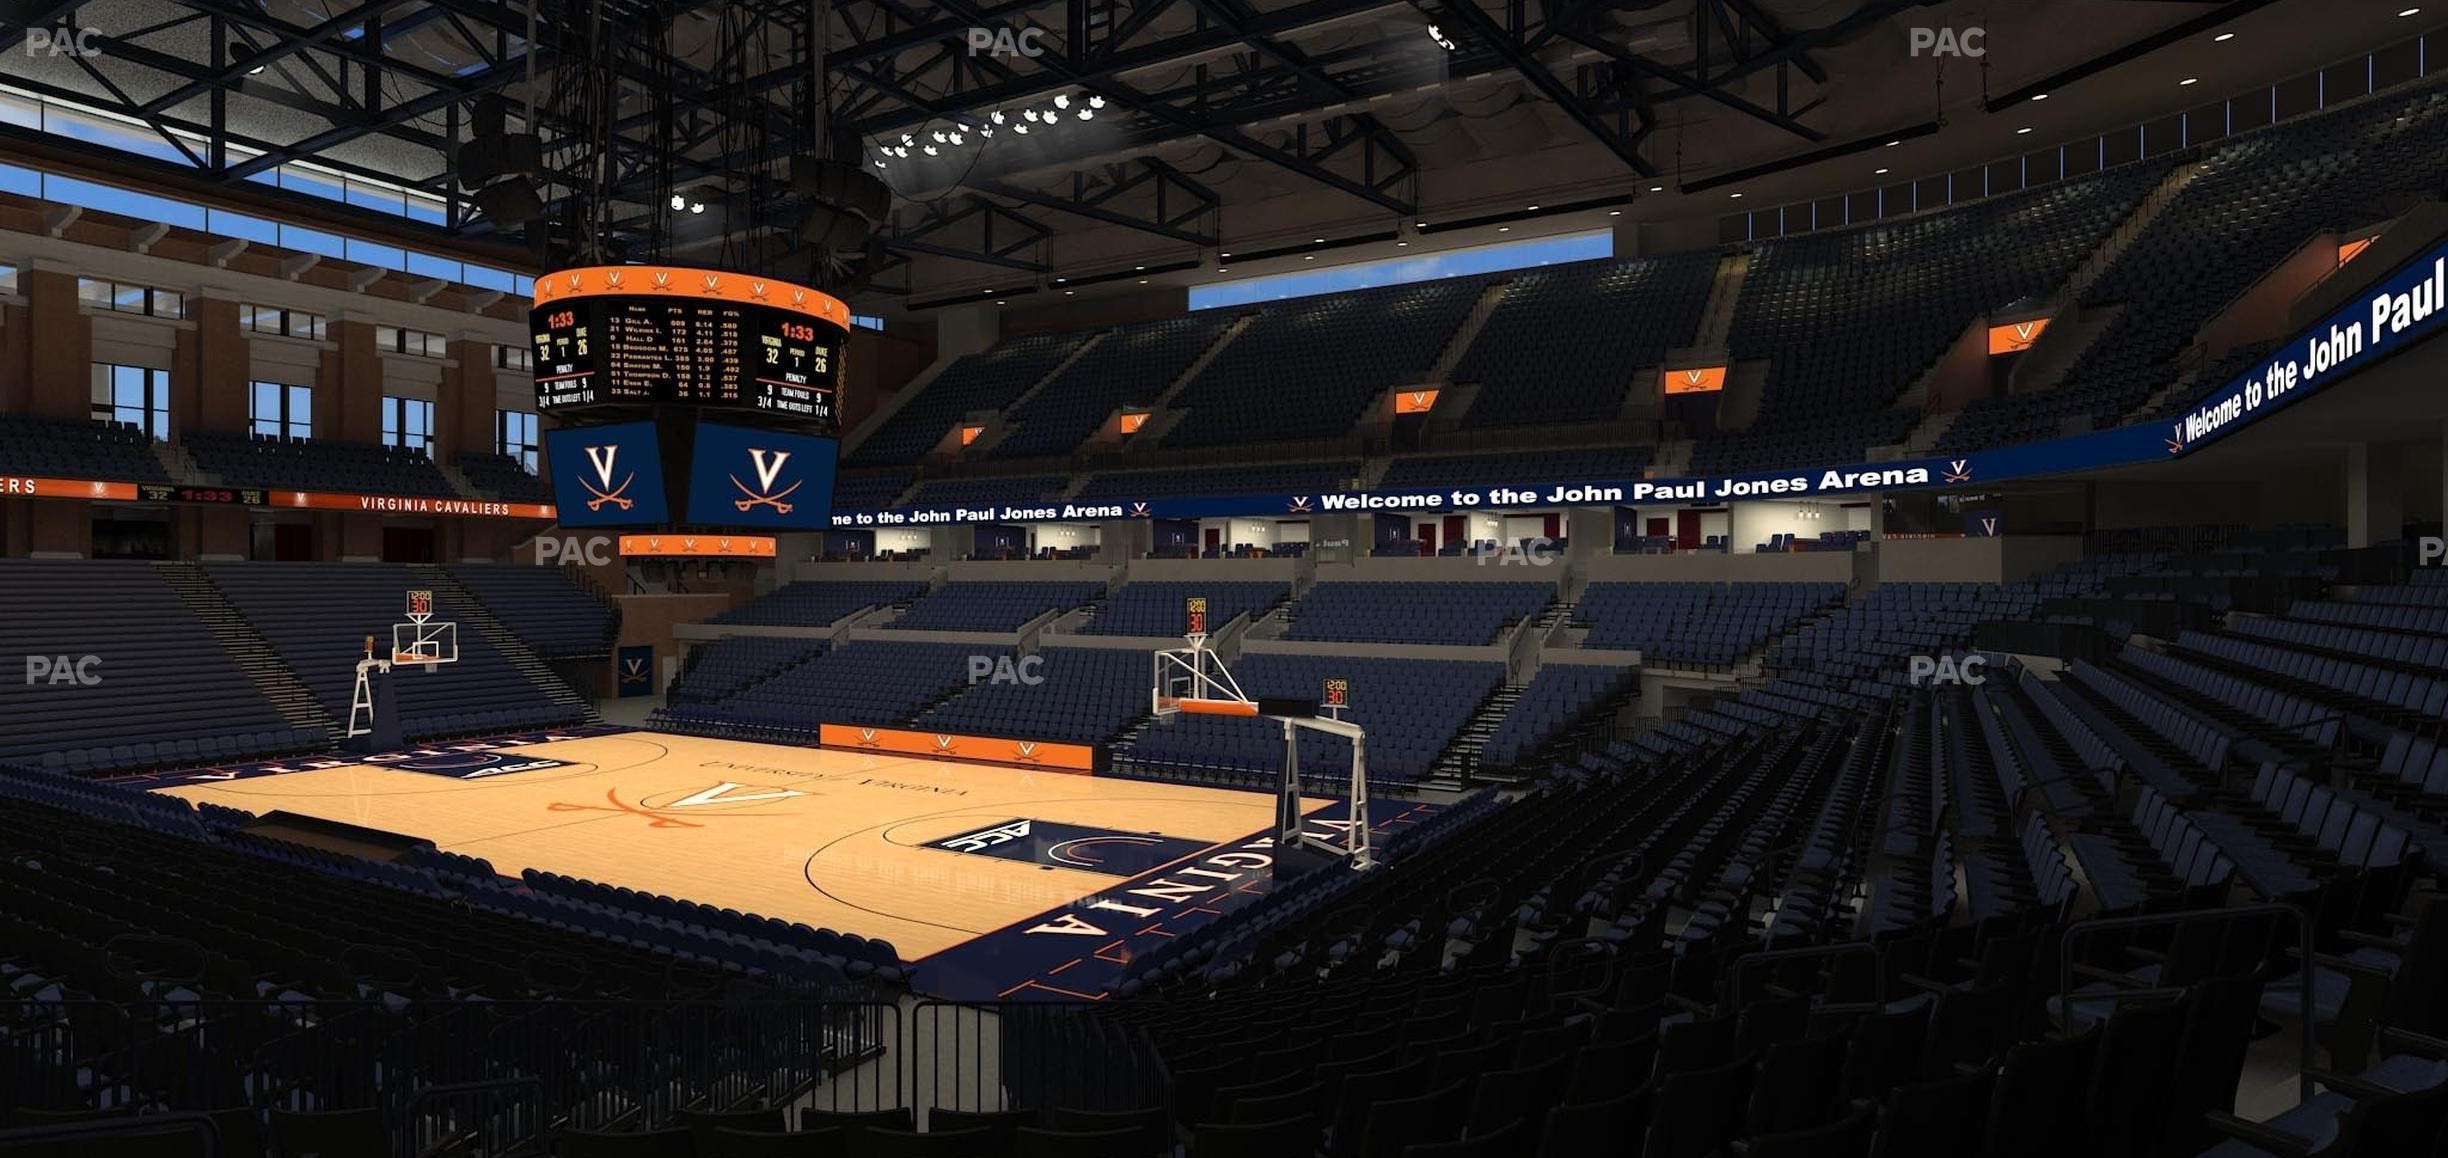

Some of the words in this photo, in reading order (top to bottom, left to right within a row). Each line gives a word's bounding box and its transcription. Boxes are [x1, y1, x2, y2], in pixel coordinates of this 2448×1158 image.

[548, 311, 574, 329] 1:33
[782, 322, 814, 341] 1:33
[540, 345, 550, 361] 32
[561, 346, 565, 357] 1
[766, 348, 778, 364] 32
[2185, 393, 2242, 443] Welcome
[2245, 379, 2262, 411] to
[2267, 360, 2298, 400] the
[2303, 321, 2362, 380] John
[2372, 257, 2445, 345] Paul
[795, 357, 799, 367] 1
[815, 357, 827, 372] 26
[786, 372, 807, 384] PENALTY
[583, 390, 594, 403] 1/4
[767, 384, 773, 395] 9
[816, 392, 822, 403] 9
[757, 396, 771, 408] 3/4
[815, 405, 828, 417] 1/4
[149, 491, 168, 500] 32
[181, 489, 232, 502] 1:33
[1322, 493, 1443, 510] Welcome
[1451, 491, 1480, 506] to
[1488, 488, 1538, 504] the
[1546, 486, 1622, 503] John
[1634, 481, 1705, 499] Paul
[1714, 477, 1808, 496] Jones
[1818, 468, 1929, 490] Arena
[361, 496, 428, 512] VIRGINIA
[435, 500, 509, 515] CAVALIERS
[856, 513, 873, 524] to
[878, 512, 904, 523] the
[909, 510, 950, 522] John
[956, 508, 994, 521] Paul
[1000, 506, 1056, 520] Jones
[1063, 504, 1122, 518] Arena
[412, 600, 428, 613] 30
[1191, 613, 1203, 632] 30
[1328, 690, 1343, 704] 30
[940, 820, 1031, 853] ACC
